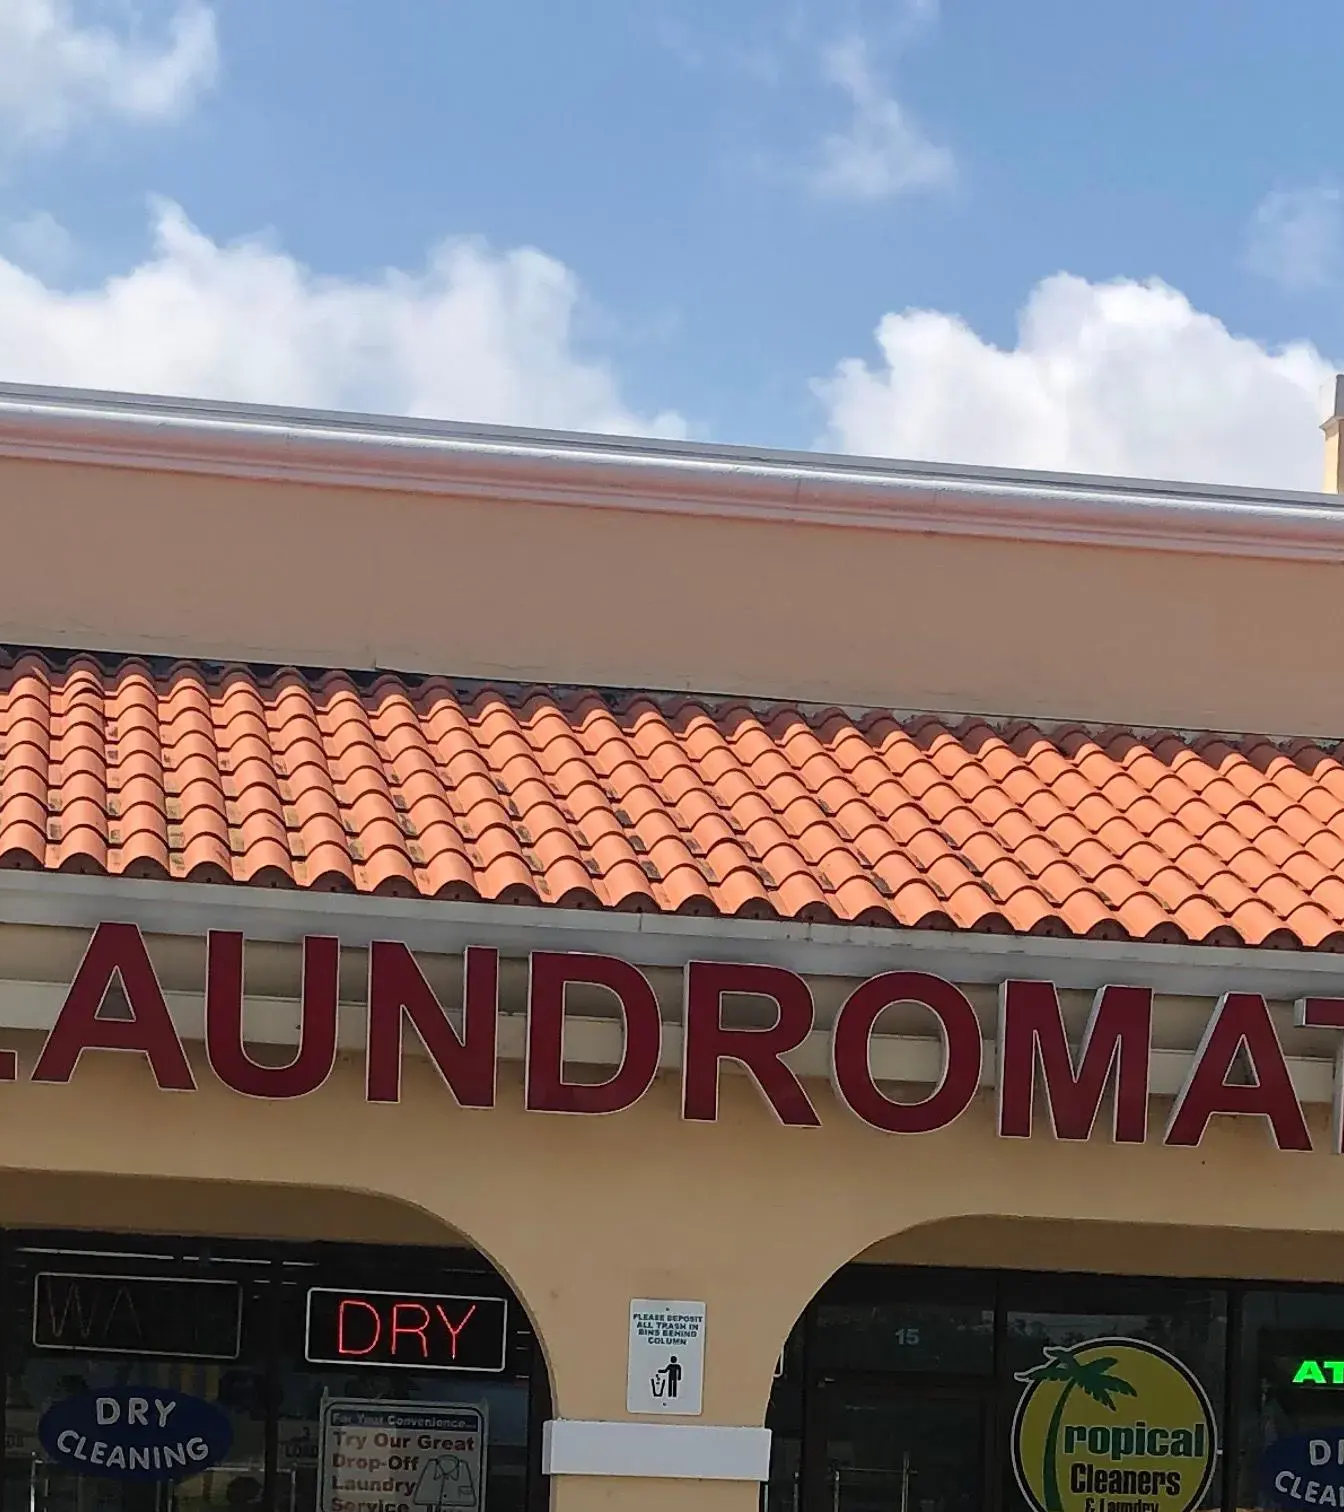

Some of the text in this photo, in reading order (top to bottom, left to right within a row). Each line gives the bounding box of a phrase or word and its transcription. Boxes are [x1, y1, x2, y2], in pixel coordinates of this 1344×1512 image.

[633, 1313, 703, 1323] PLEASE DEPOSIT
[636, 1321, 654, 1329] ALL
[656, 1322, 686, 1330] TRASH
[338, 1299, 477, 1361] DRY
[638, 1328, 697, 1337] BINS BEHIND
[895, 1328, 920, 1346] 15
[647, 1336, 687, 1345] COLUMN
[95, 1397, 176, 1428] DRY
[57, 1430, 209, 1470] CLEANING
[333, 1431, 475, 1451] Try Our Great
[332, 1453, 420, 1473] Drop-Off
[332, 1475, 417, 1496] Laundry
[1070, 1463, 1181, 1496] Cleaners
